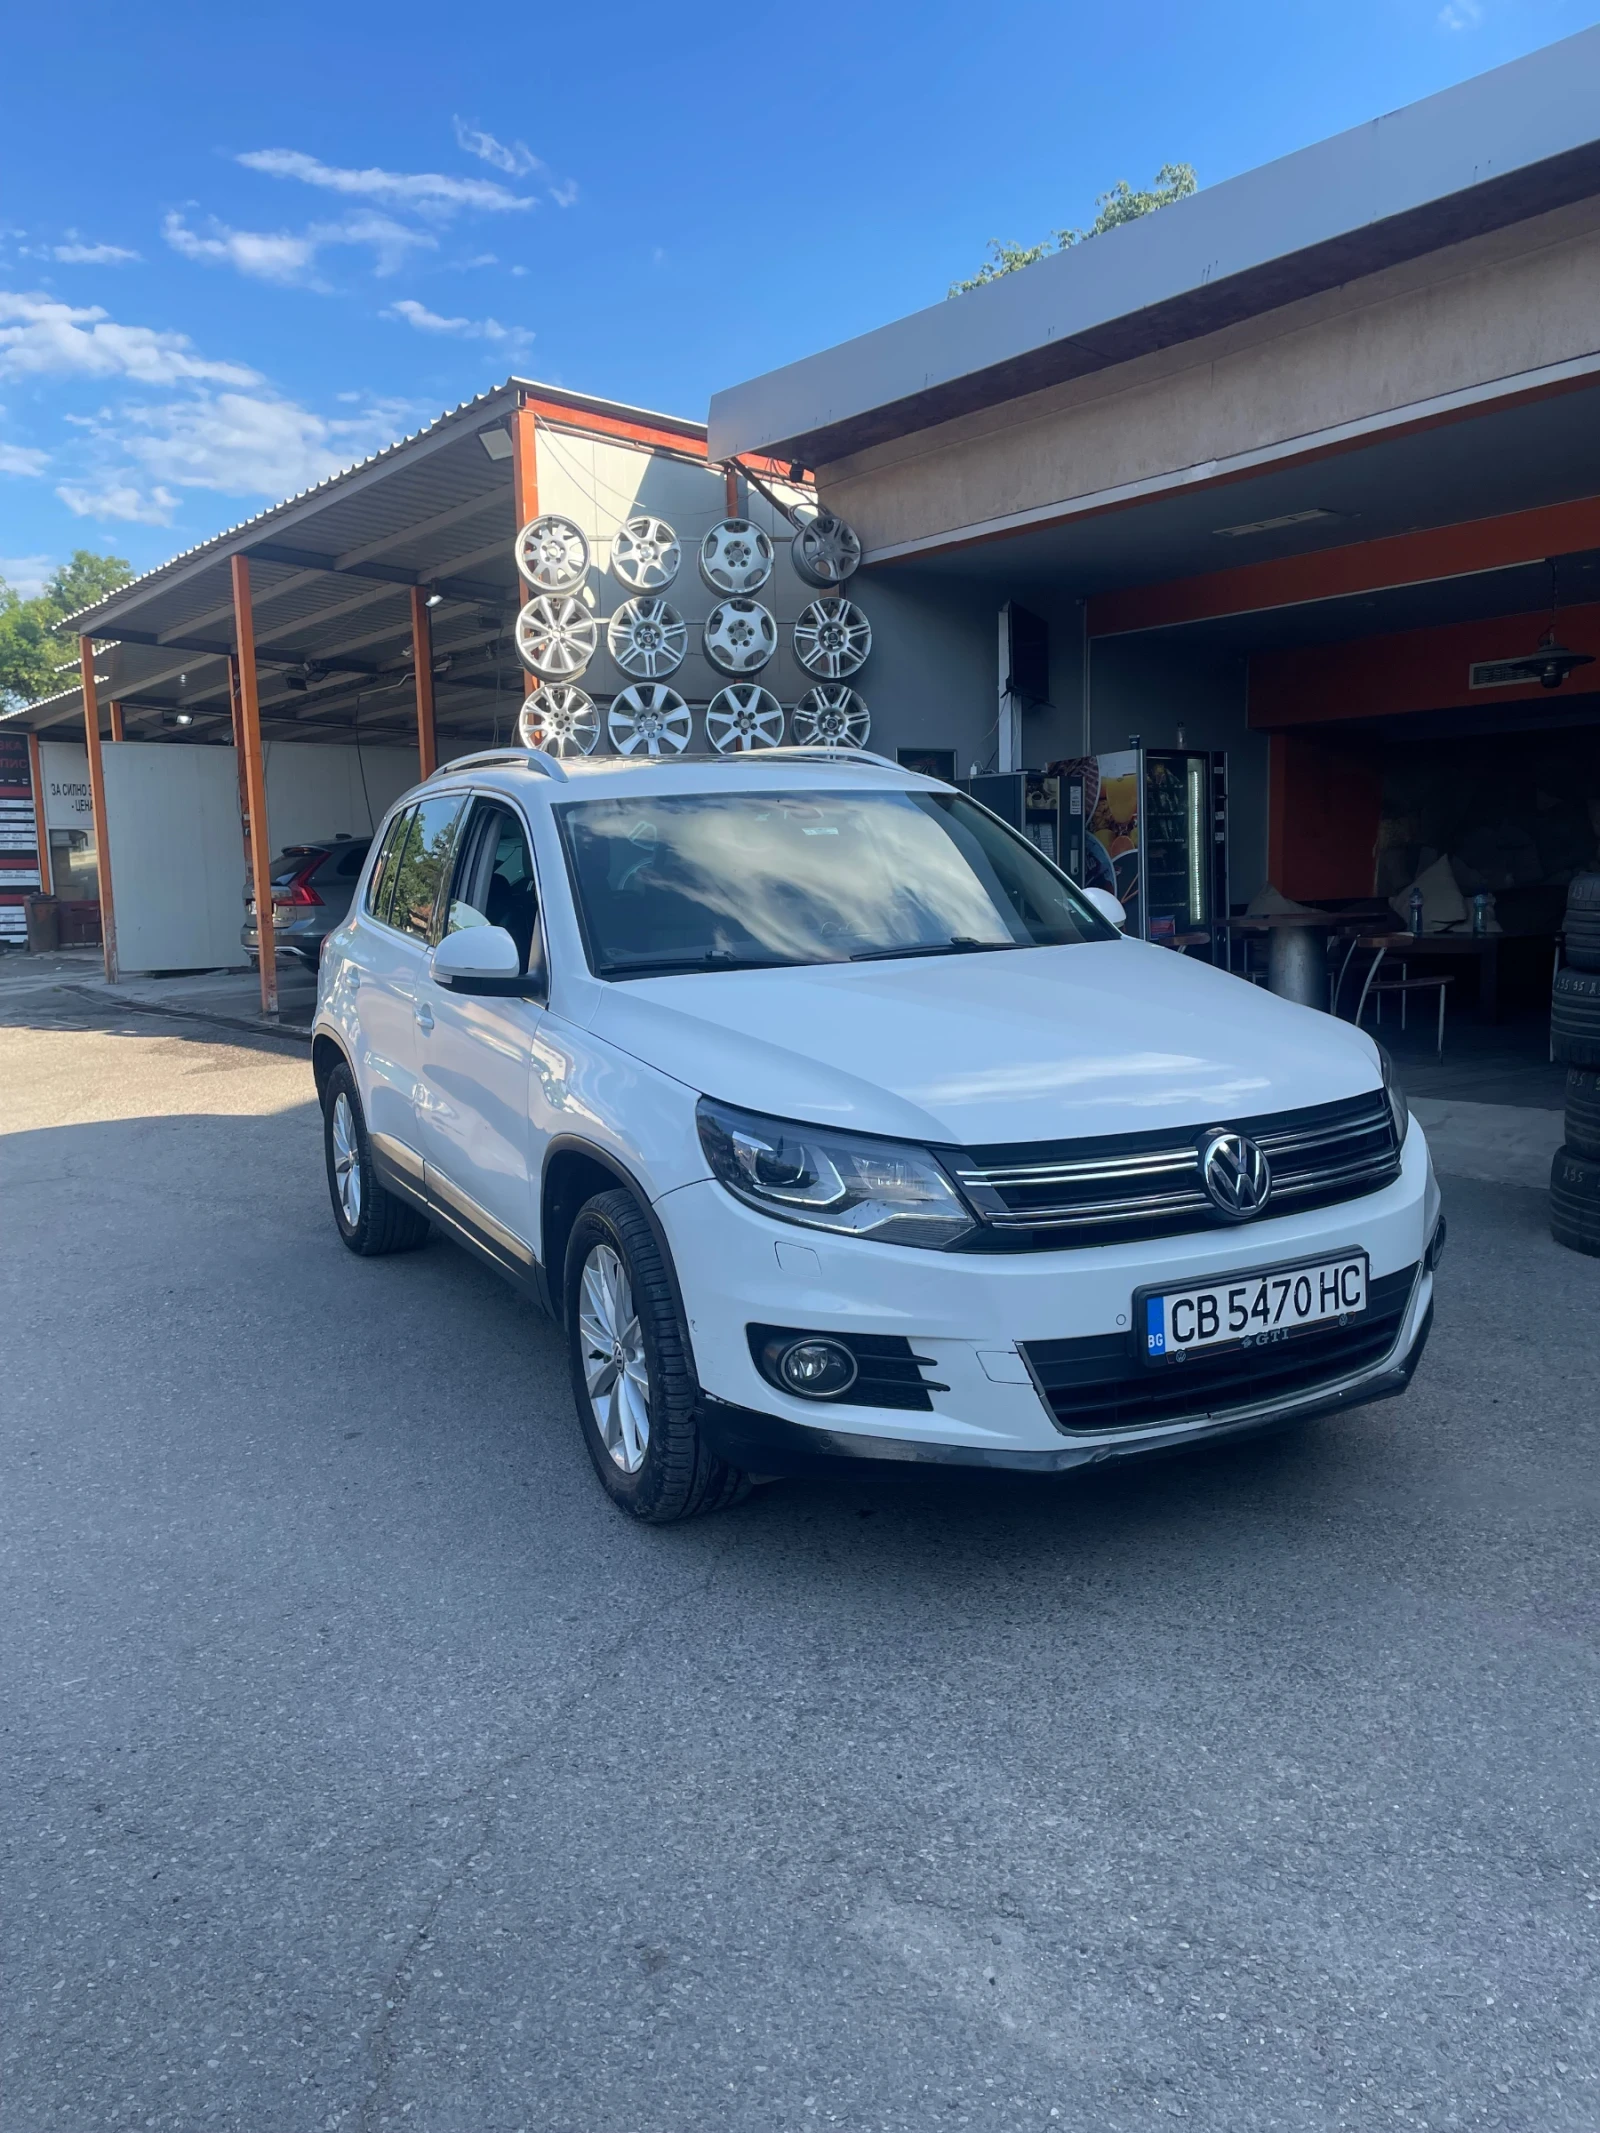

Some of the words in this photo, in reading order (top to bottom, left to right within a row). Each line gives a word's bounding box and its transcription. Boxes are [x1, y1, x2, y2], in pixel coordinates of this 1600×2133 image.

[51, 783, 61, 796] ЗА
[62, 783, 87, 796] СИЛНО
[1228, 1276, 1312, 1332] 5470
[1148, 1333, 1164, 1348] BG
[1255, 1327, 1290, 1346] GTI
